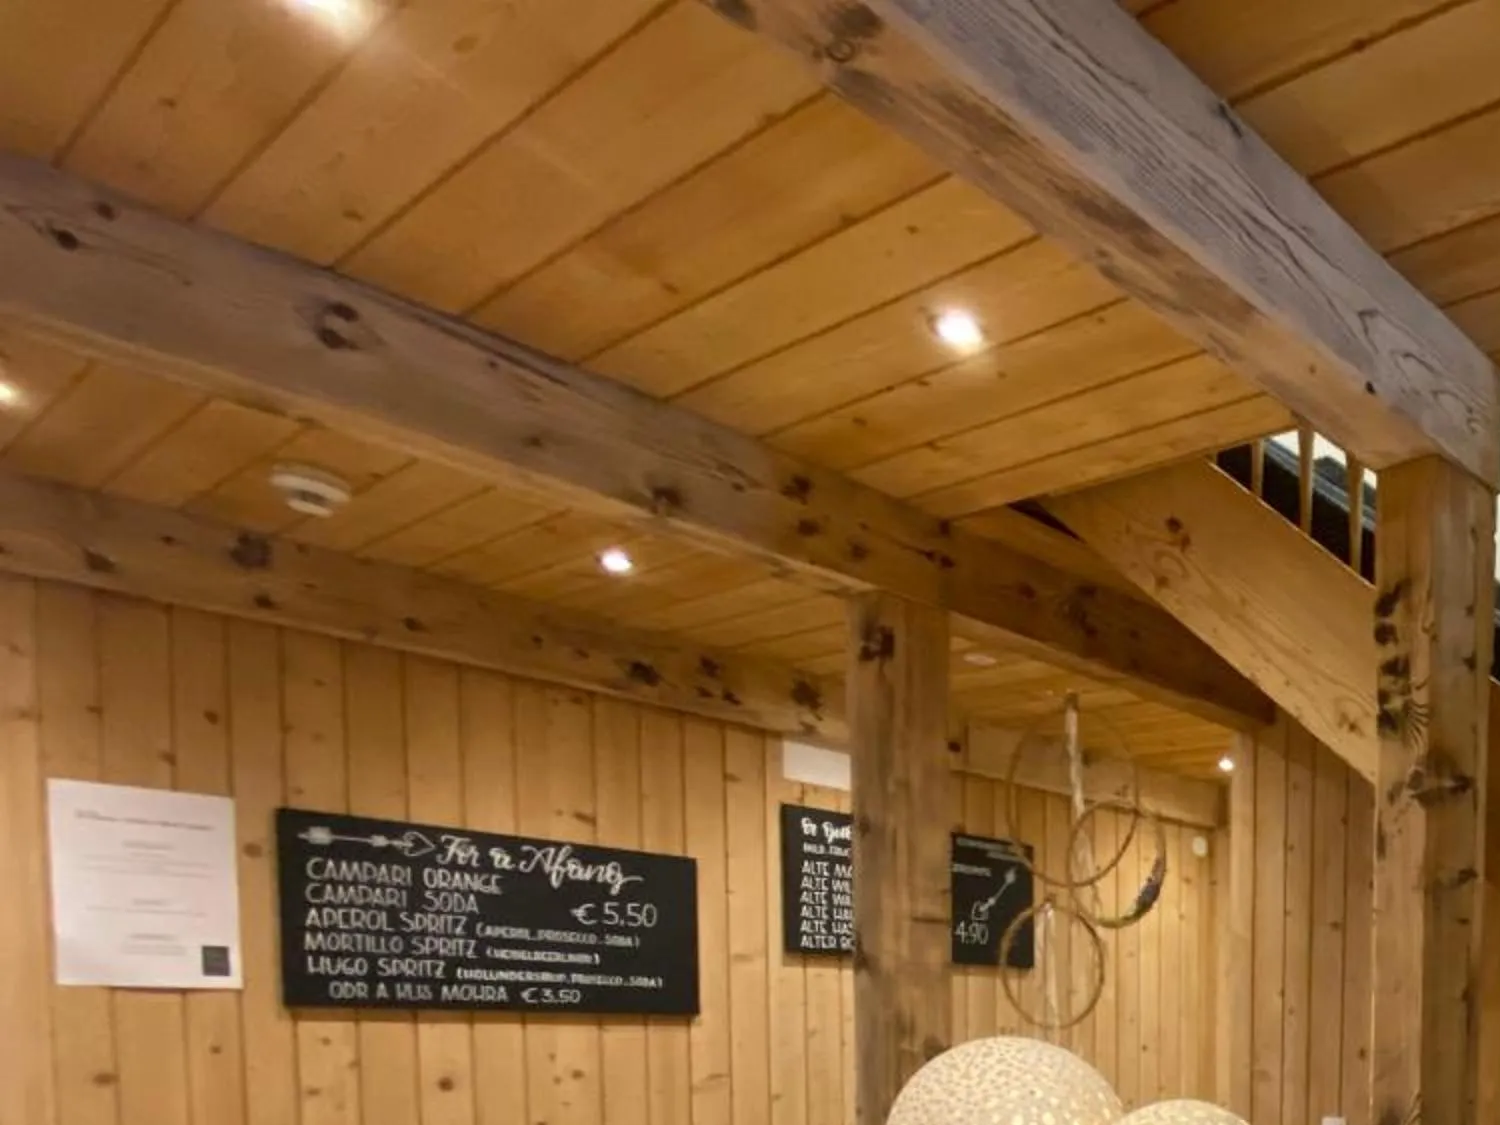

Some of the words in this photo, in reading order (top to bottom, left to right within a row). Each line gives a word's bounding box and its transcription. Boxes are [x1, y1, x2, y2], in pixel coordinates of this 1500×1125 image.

[305, 856, 412, 887] CAMPARI
[422, 867, 503, 895] ORANGE
[304, 882, 408, 908] CAMPARI
[421, 889, 480, 915] SODA
[304, 906, 396, 933] APEROL
[399, 911, 469, 936] SPRITZ
[304, 930, 404, 954] MORTILLO
[410, 935, 479, 959] SPRITZ
[306, 954, 369, 977] HUGO
[376, 958, 447, 979] SPRITZ
[375, 981, 390, 1000] A
